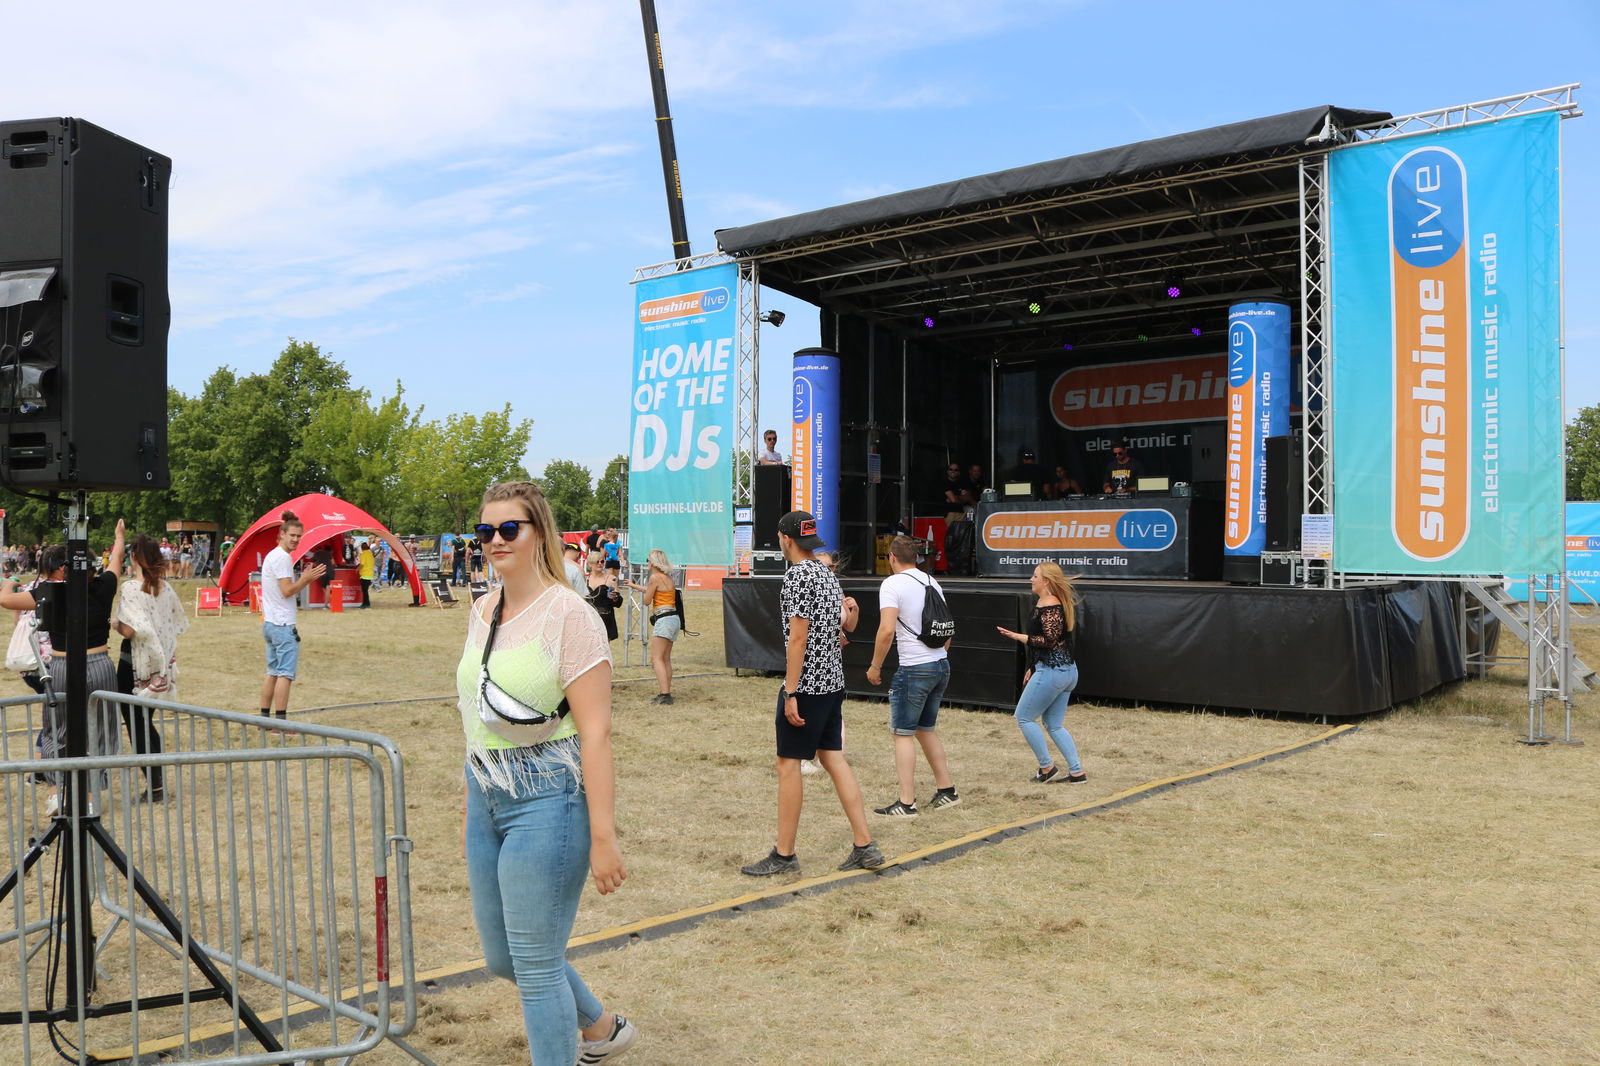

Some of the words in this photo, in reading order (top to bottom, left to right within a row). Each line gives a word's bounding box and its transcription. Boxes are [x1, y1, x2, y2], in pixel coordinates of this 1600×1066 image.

[654, 32, 663, 70] WIEMANN
[672, 159, 682, 199] WIEMANN
[1410, 164, 1443, 254] live
[1480, 232, 1497, 296] radio
[640, 300, 698, 318] sunshine
[704, 294, 725, 306] live
[638, 337, 732, 380] HOME
[1230, 331, 1243, 380] live
[1480, 303, 1498, 380] music
[634, 380, 668, 412] OF
[676, 374, 727, 408] THE
[794, 384, 804, 418] live
[1260, 372, 1270, 406] radio
[1412, 278, 1445, 542] sunshine
[631, 410, 722, 472] DJs
[1085, 432, 1176, 452] eletronic
[1480, 388, 1499, 514] electronic
[1228, 393, 1242, 539] sunshine
[633, 501, 724, 514] SUNSHINE-LIVE.DE
[989, 520, 1110, 539] sunshine
[1122, 520, 1168, 538] live
[1058, 556, 1092, 566] music
[1096, 556, 1128, 566] radio
